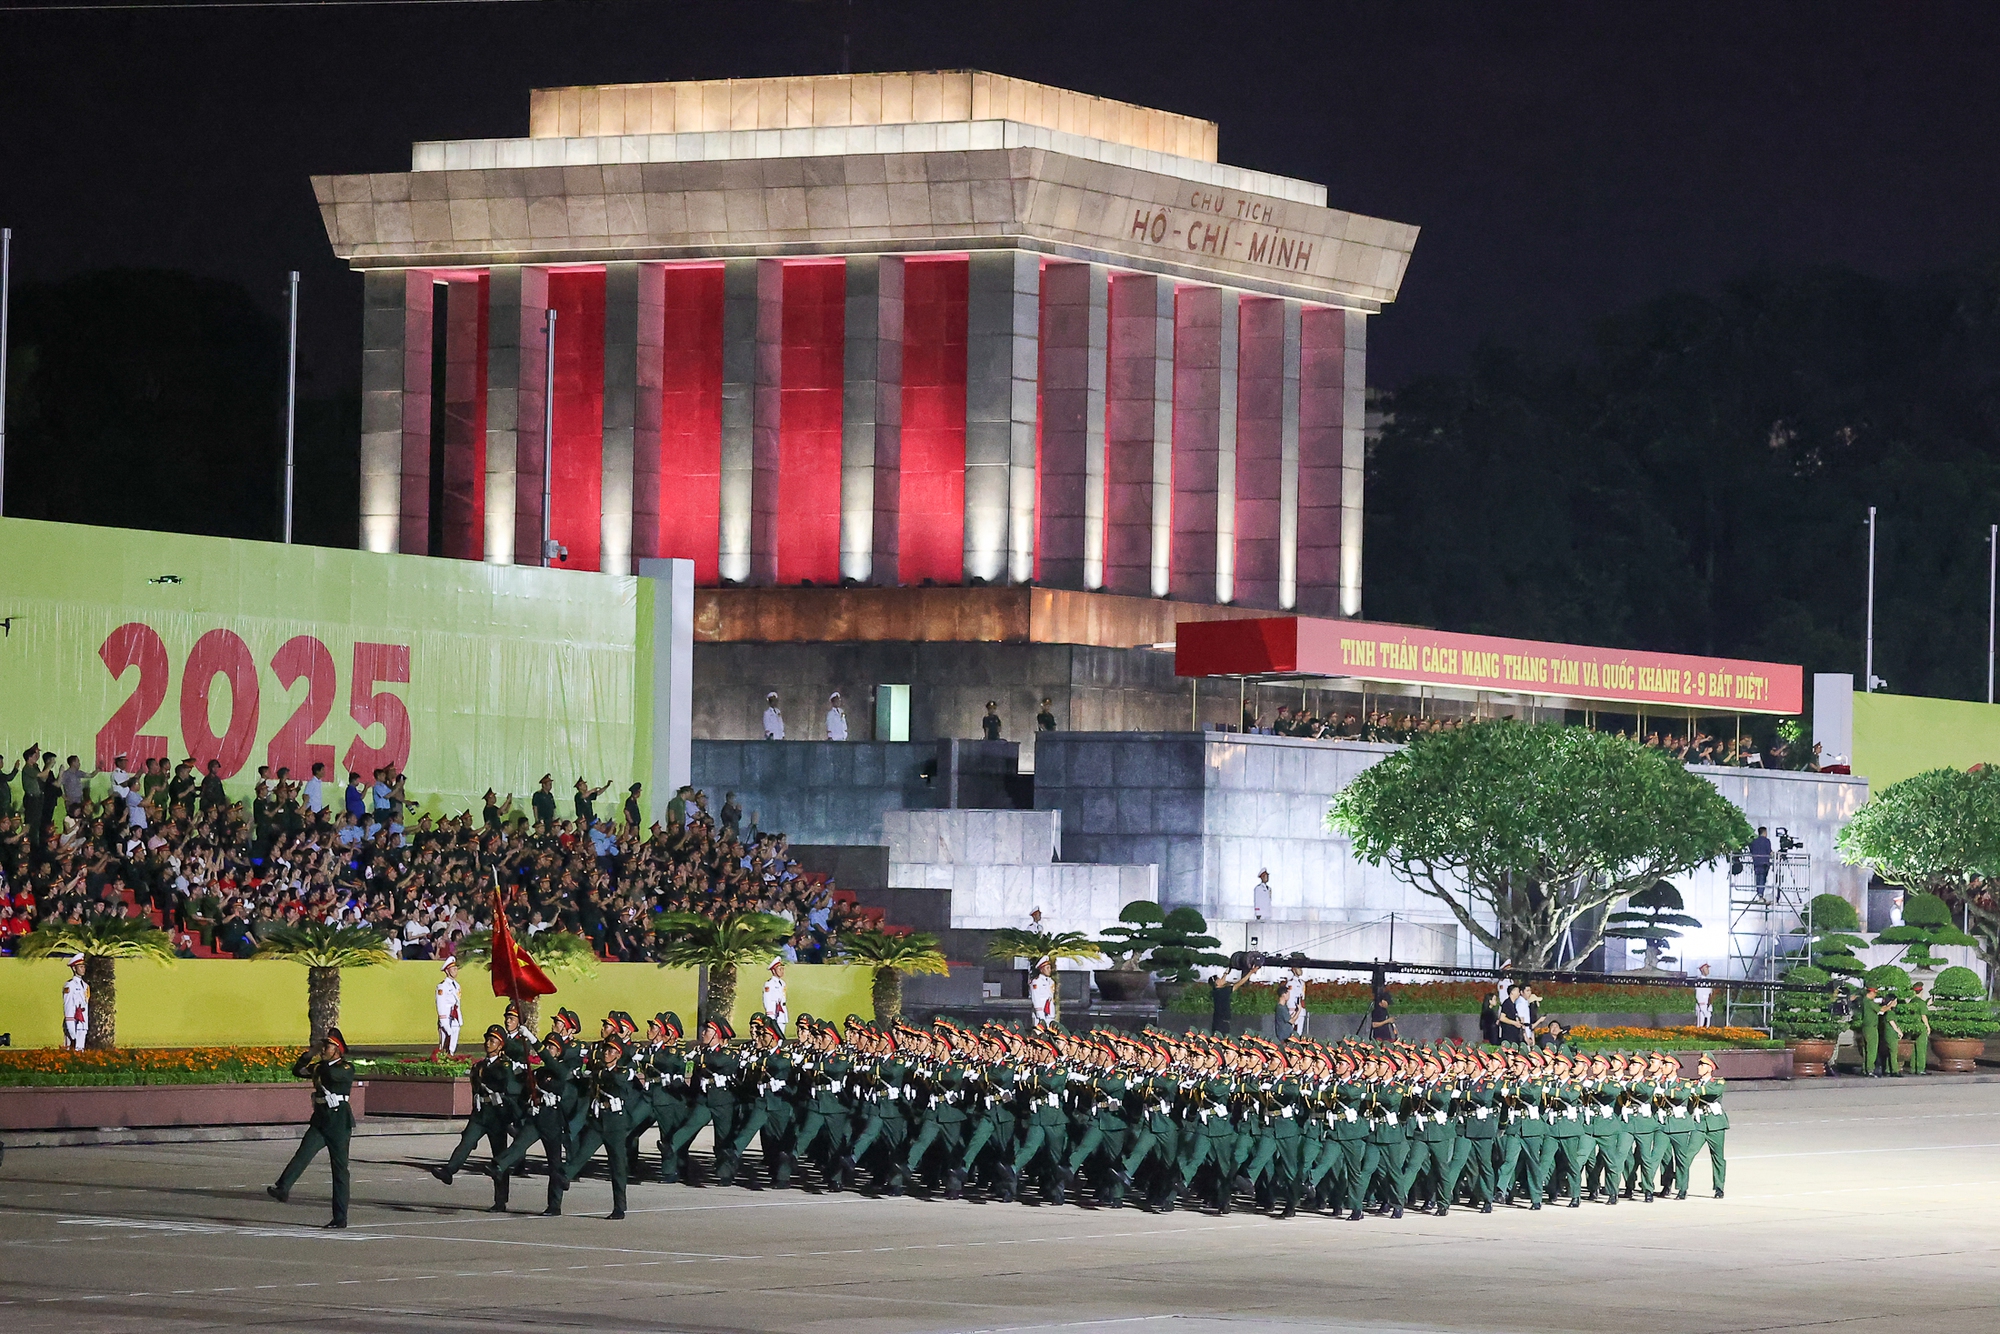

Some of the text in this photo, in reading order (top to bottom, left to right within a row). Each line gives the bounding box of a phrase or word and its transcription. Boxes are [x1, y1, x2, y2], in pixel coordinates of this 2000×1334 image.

[96, 622, 411, 785] 2025
[1340, 636, 1769, 704] TINH THẦN CÁCH MẠNG THÁNG TÁM VÀ QUỐC KHÁNH 2-9 BẤT DIỆT!
